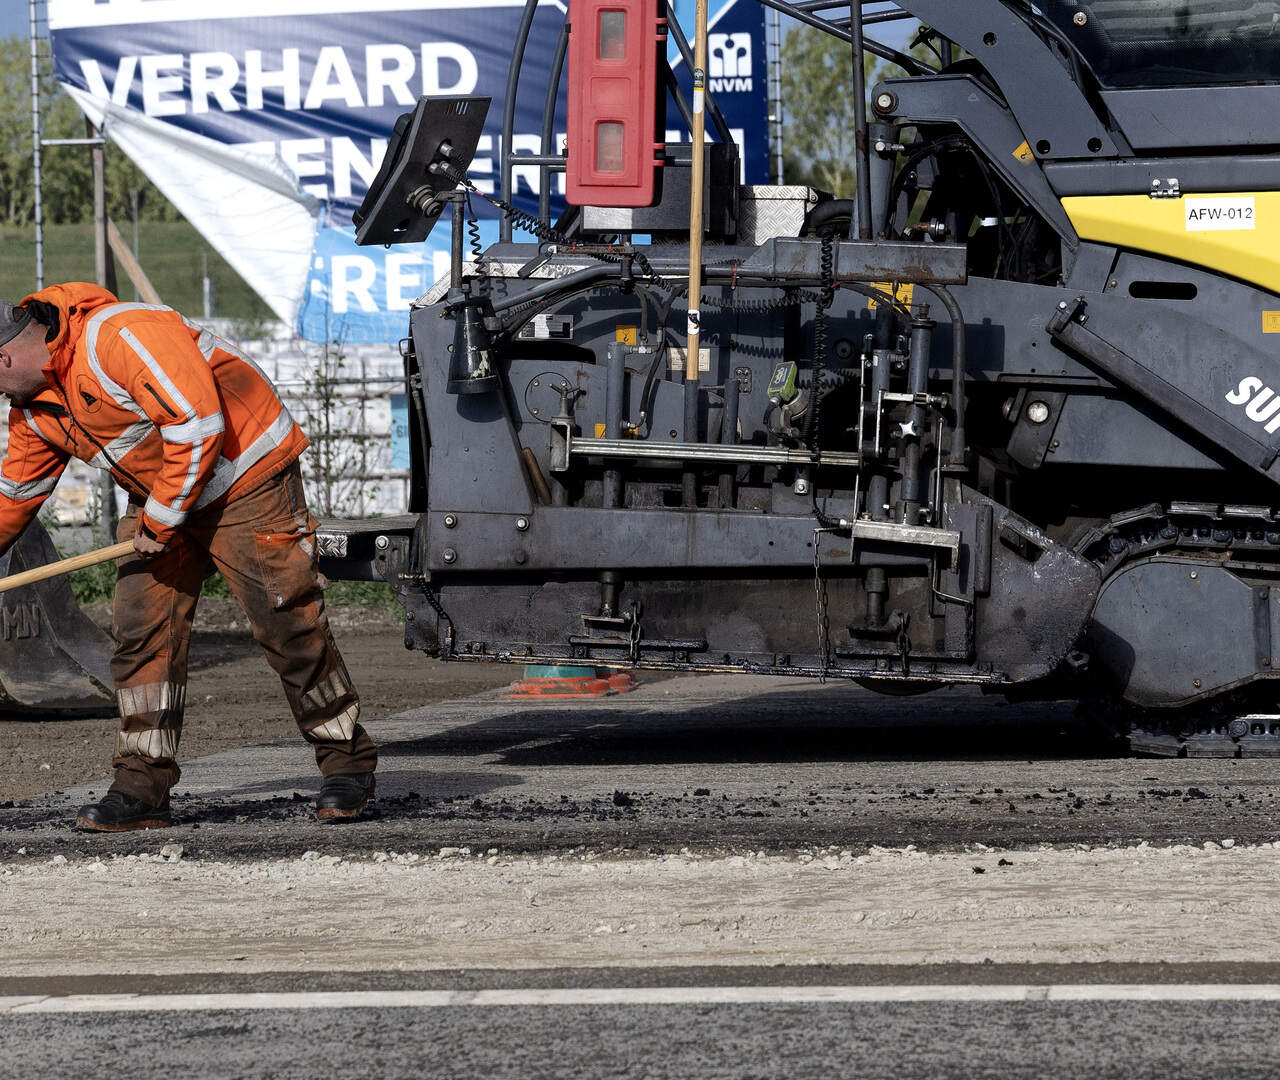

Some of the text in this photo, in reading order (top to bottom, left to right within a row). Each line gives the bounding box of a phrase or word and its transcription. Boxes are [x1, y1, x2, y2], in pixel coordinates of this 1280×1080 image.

[79, 41, 479, 117] VERHARD
[709, 77, 753, 93] NVM
[1188, 207, 1253, 221] AFW-012
